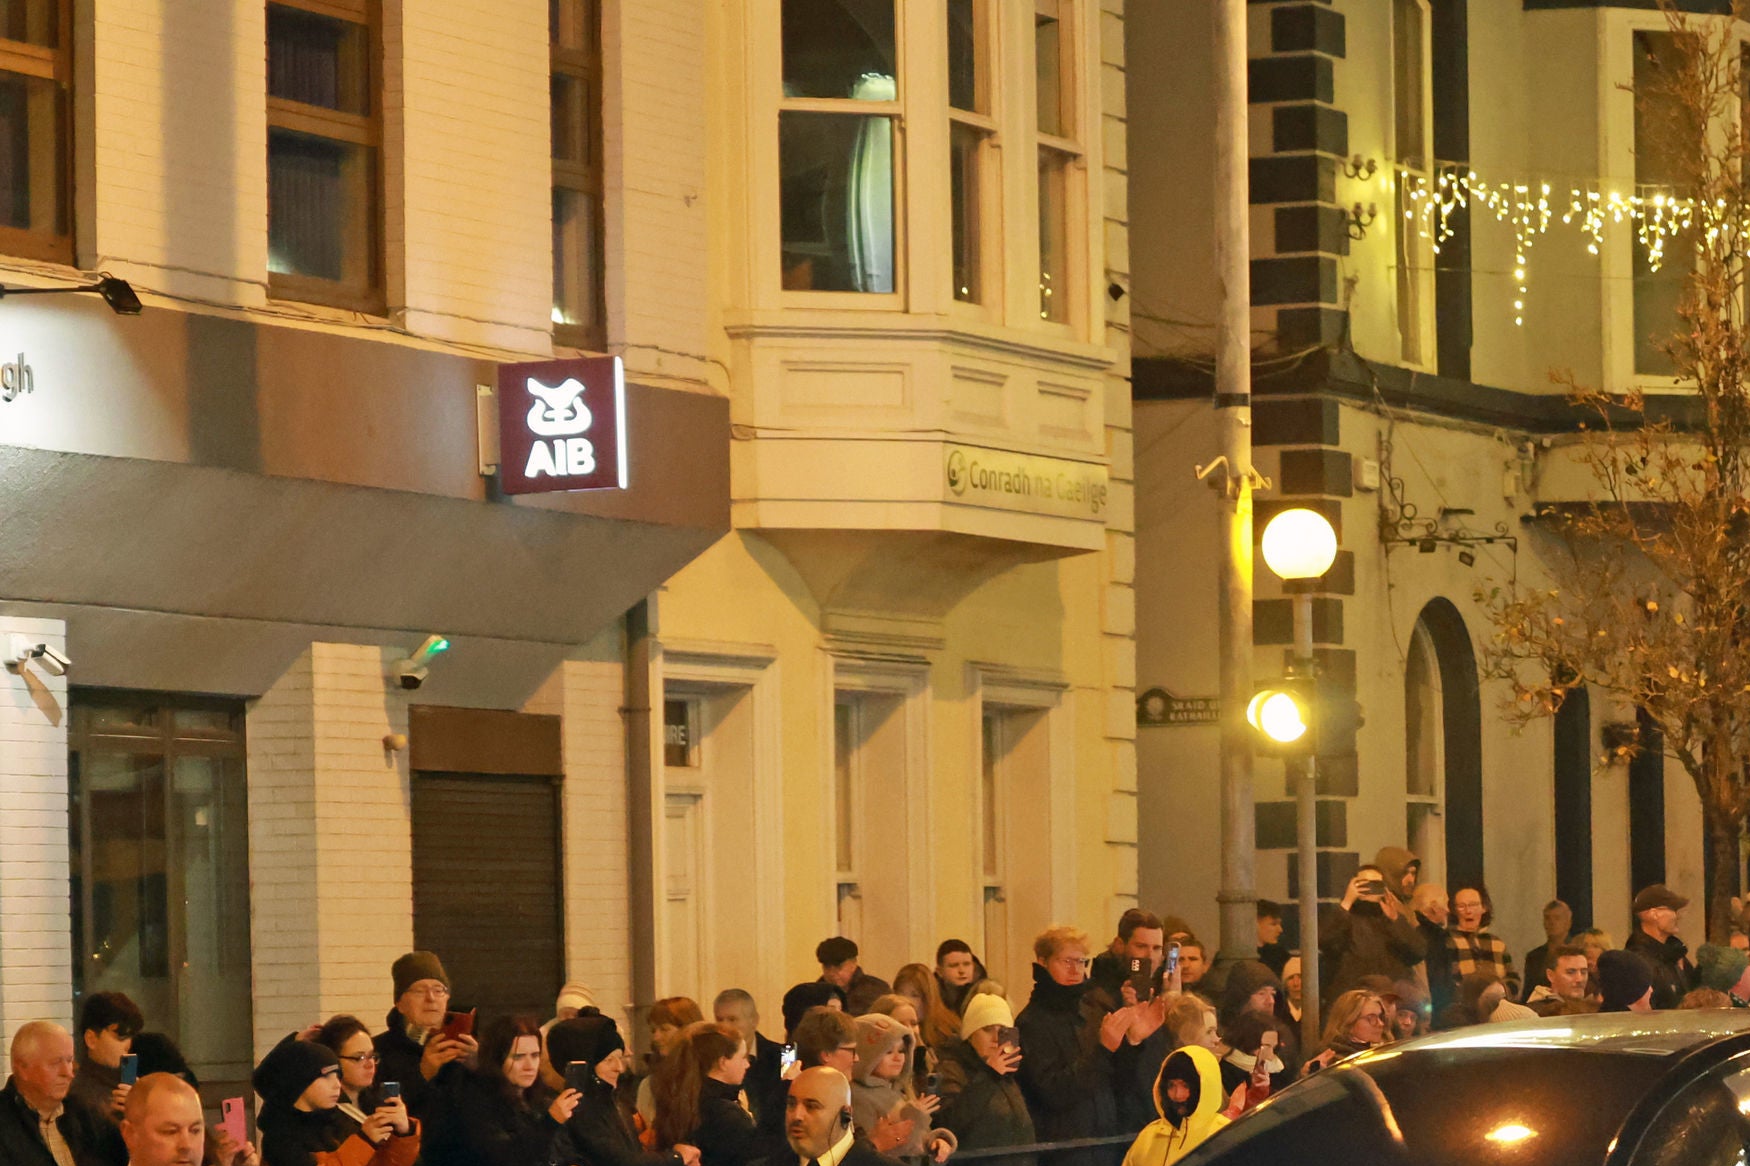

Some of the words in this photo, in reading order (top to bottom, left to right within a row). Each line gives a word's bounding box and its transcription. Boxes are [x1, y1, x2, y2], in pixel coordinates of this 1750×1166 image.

[524, 437, 596, 478] AIB
[969, 461, 1031, 496] Conradh
[1034, 475, 1053, 498] na
[1055, 472, 1107, 514] Gaeilge
